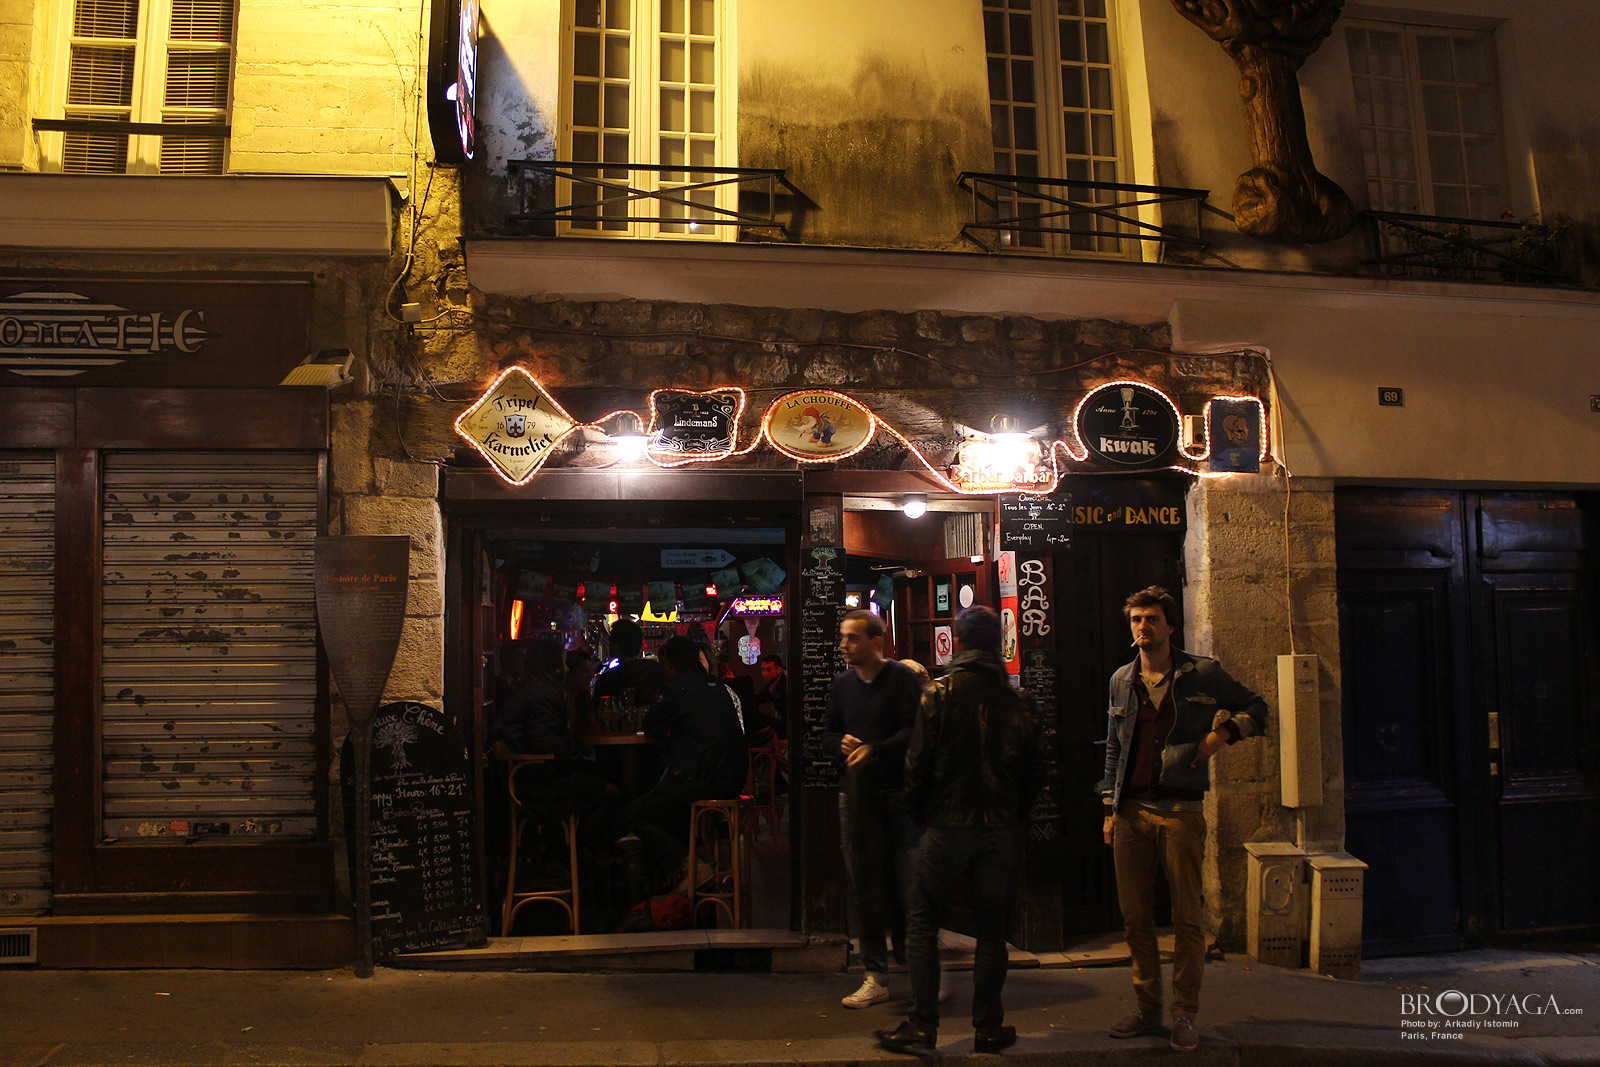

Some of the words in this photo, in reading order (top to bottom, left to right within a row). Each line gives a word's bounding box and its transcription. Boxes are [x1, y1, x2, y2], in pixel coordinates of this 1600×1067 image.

[492, 393, 540, 413] Tripel
[786, 399, 800, 409] LA
[802, 396, 854, 411] CHOUFFE
[1384, 391, 1398, 402] 69
[482, 432, 552, 456] Karmeliet
[1107, 506, 1122, 522] and
[1125, 506, 1181, 525] DANCE
[1023, 522, 1044, 530] OPEN
[721, 554, 727, 562] 5
[361, 573, 371, 582] de
[374, 573, 397, 582] Paris
[1019, 558, 1050, 637] BAR
[403, 704, 445, 736] Chêne
[370, 792, 392, 808] appy
[395, 786, 425, 799] Hours
